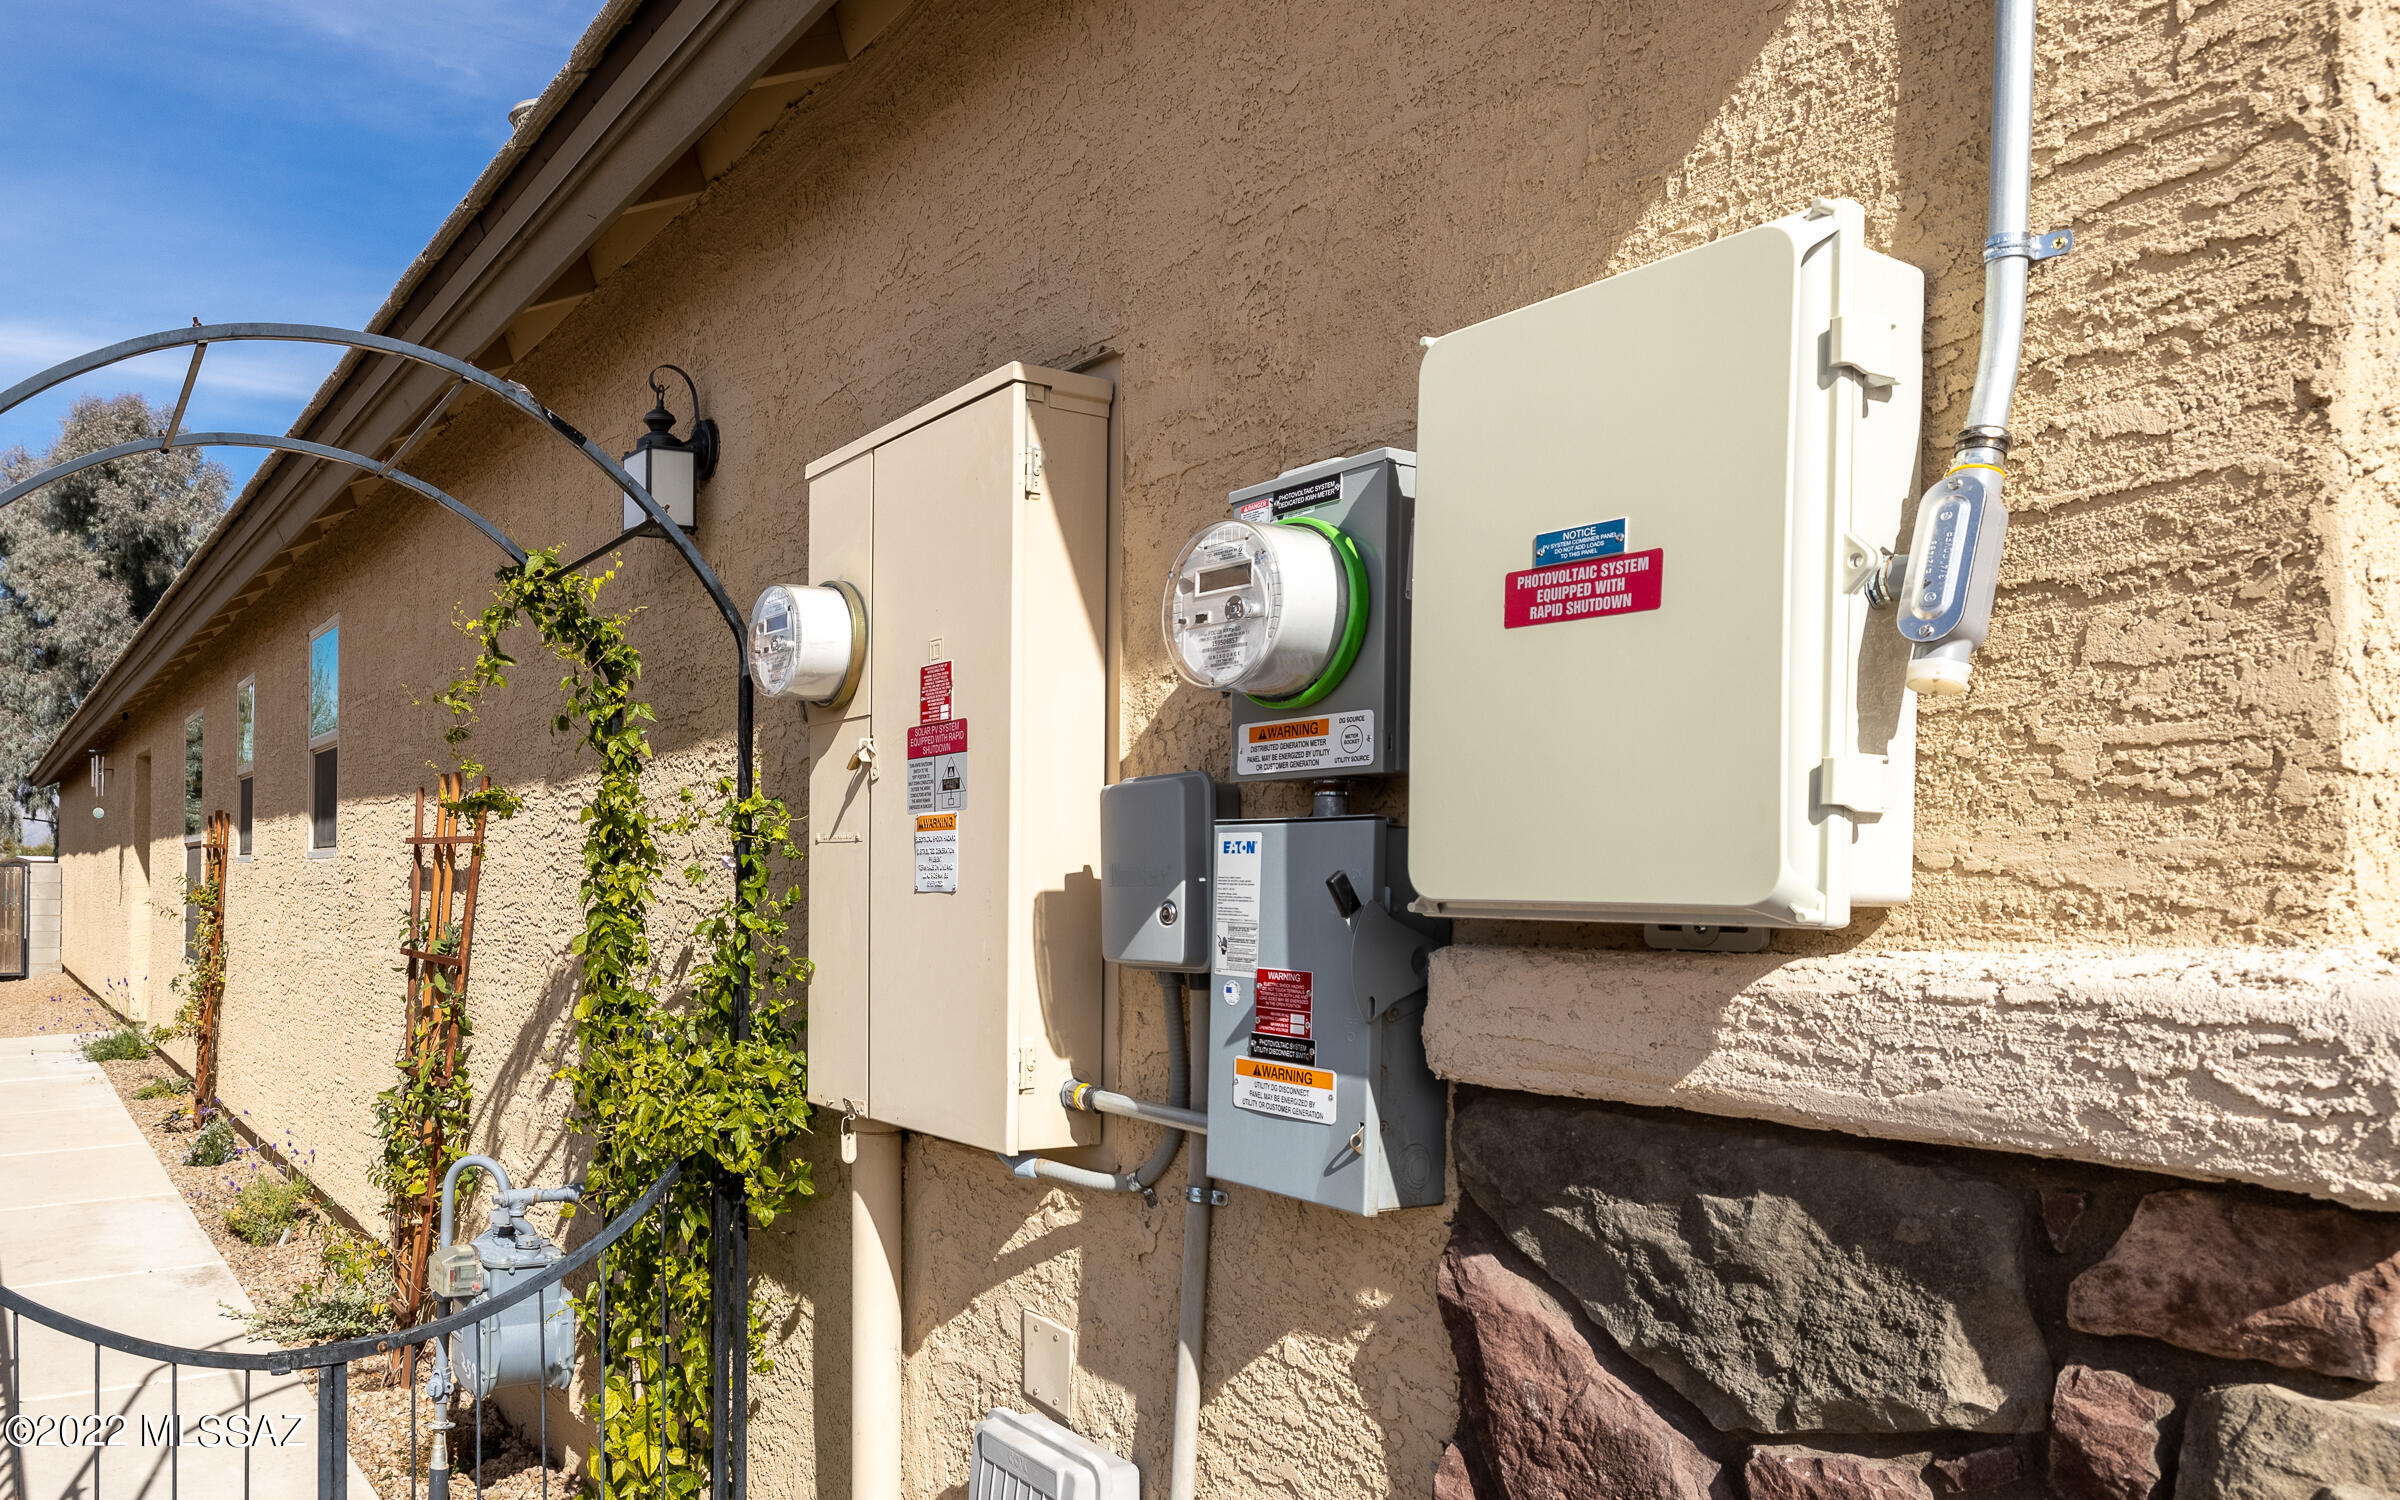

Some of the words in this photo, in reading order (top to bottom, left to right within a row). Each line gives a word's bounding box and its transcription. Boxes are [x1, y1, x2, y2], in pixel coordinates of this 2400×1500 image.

[1279, 487, 1314, 500] PHOTOVOLTAIC
[1315, 481, 1335, 492] SYSTEM
[1278, 498, 1304, 508] DEDICATED
[1317, 489, 1335, 499] METER
[1248, 500, 1267, 511] DANGER
[1563, 527, 1596, 540] NOTICE
[1551, 541, 1571, 549] SYSTEM
[1572, 535, 1599, 545] COMBINER
[1518, 565, 1597, 590] PHOTOVOLTAIC
[1601, 556, 1649, 577] SYSTEM
[1537, 584, 1591, 603] EQUIPPED
[1595, 577, 1625, 594] WITH
[1530, 602, 1563, 620] RAPID
[1566, 593, 1632, 616] SHUTDOWN
[915, 726, 930, 736] SOLAR
[932, 726, 939, 734] PV
[940, 722, 959, 732] SYSTEM
[1268, 722, 1318, 738] WARNING
[911, 736, 934, 747] EQUIPPED
[935, 734, 947, 743] WITH
[949, 731, 964, 740] RAPID
[923, 743, 950, 754] SHUTDOWN
[1251, 744, 1278, 752] DISTRIBUTED
[1280, 741, 1309, 750] GENERATION
[1279, 752, 1305, 760] ENERGIZED
[1313, 749, 1330, 757] UTILITY
[1264, 762, 1289, 770] CUSTOMER
[1290, 759, 1319, 768] GENERATION
[923, 817, 953, 828] WARNING
[1224, 841, 1255, 854] EATON
[1268, 972, 1300, 982] WARNING
[1259, 1039, 1289, 1049] PHOTOVOLTAIC
[1269, 1048, 1295, 1057] DISCONNECT
[1262, 1065, 1312, 1084] WARNING
[1254, 1081, 1270, 1090] UTILITY
[1279, 1085, 1309, 1096] DISCONNECT
[1281, 1096, 1308, 1107] ENERGIZED
[1266, 1103, 1291, 1114] CUSTOMER
[1292, 1108, 1323, 1119] GENERATION
